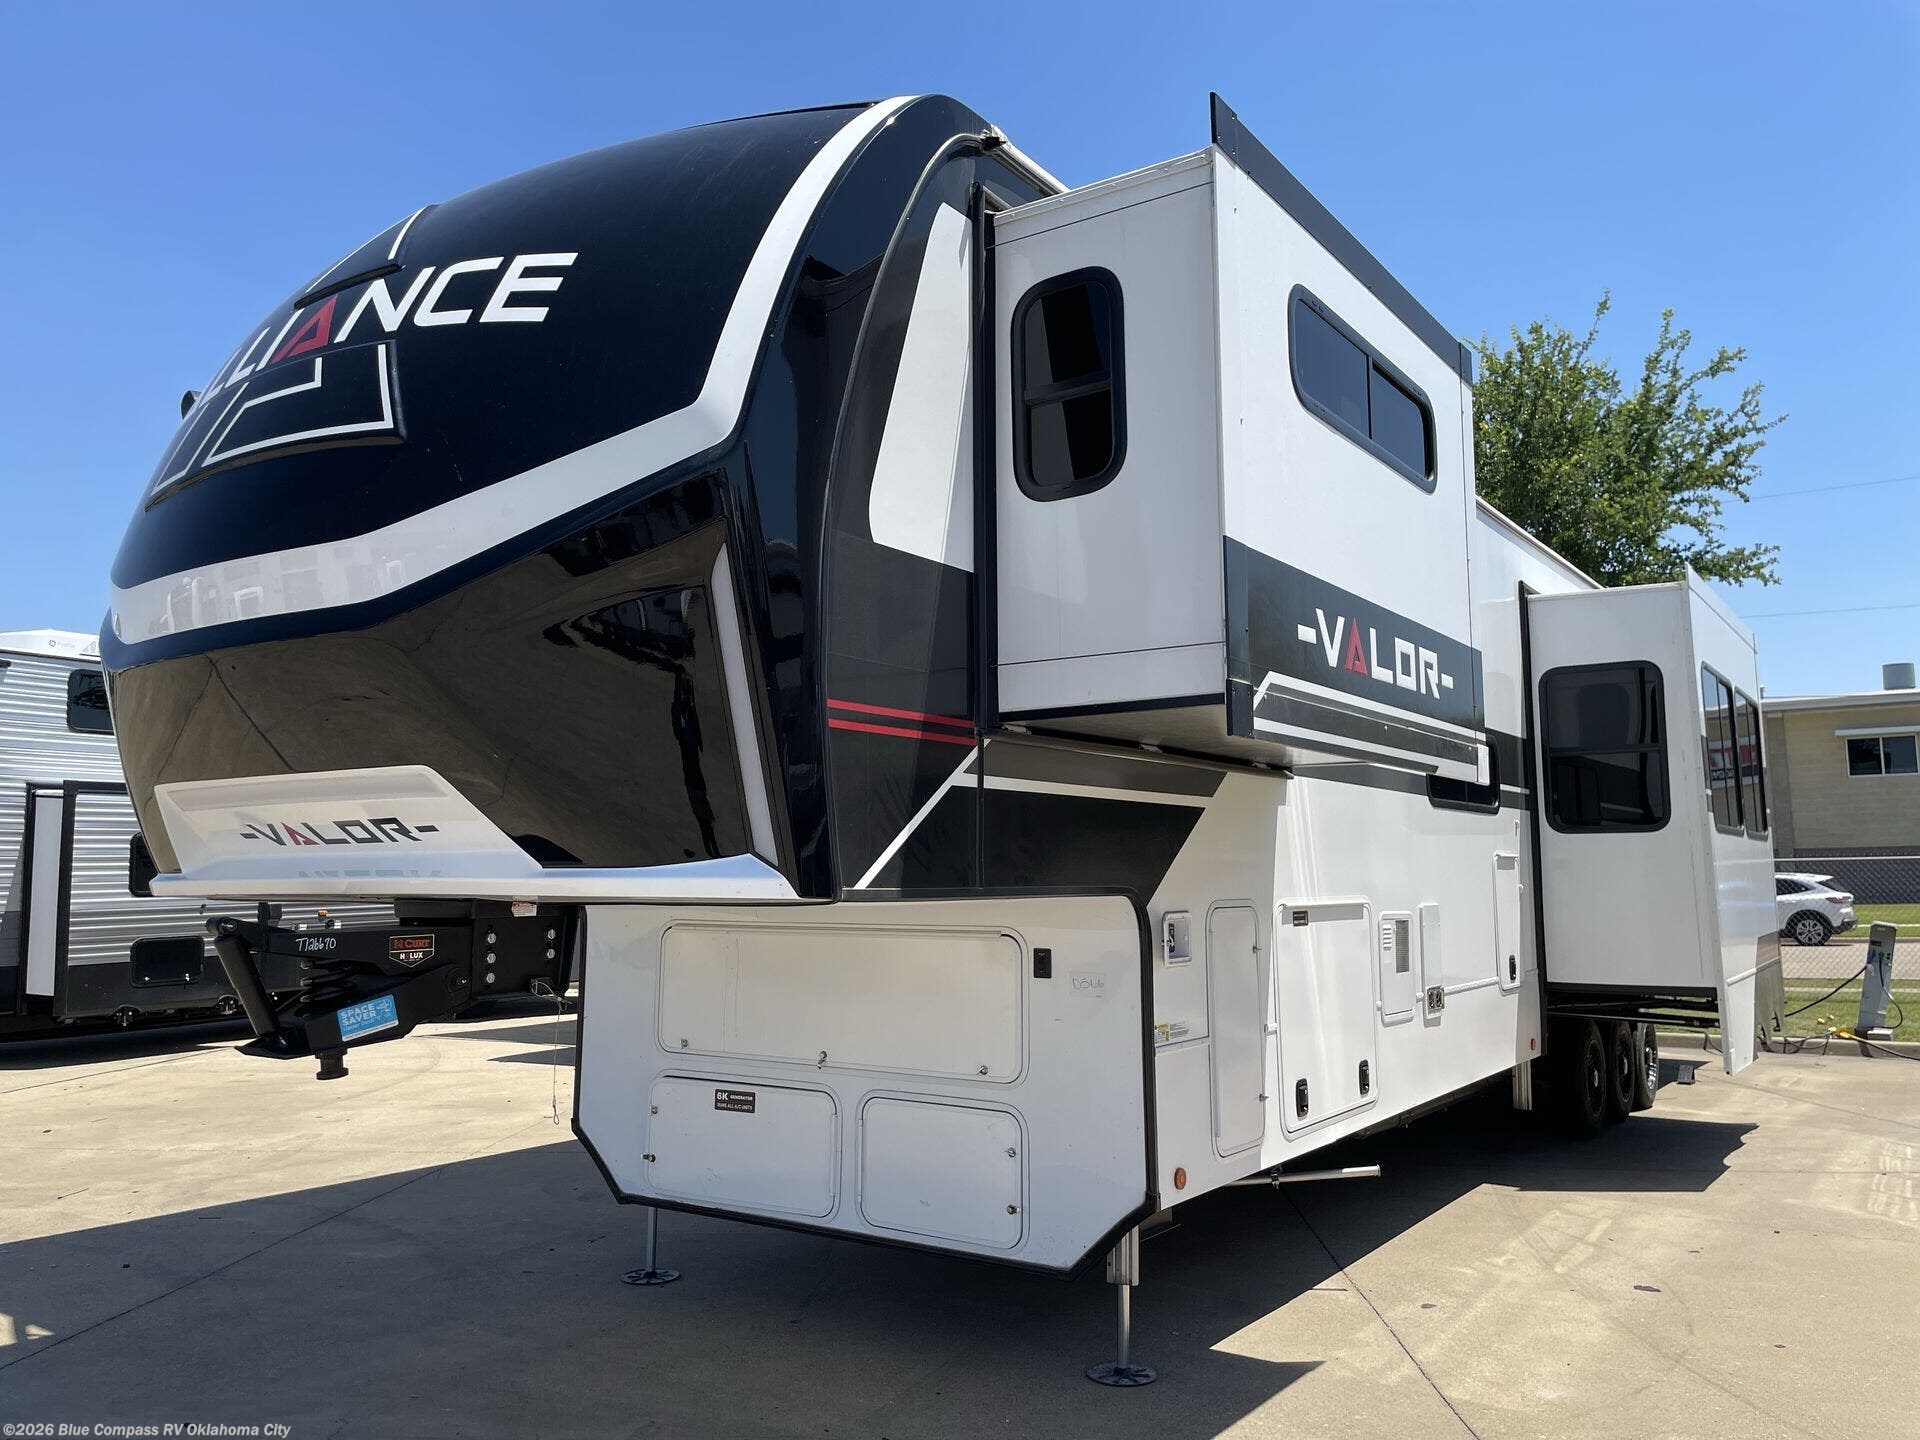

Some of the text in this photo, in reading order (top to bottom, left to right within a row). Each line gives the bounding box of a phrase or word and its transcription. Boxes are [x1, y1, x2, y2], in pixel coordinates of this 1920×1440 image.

[341, 1003, 375, 1019] SPACE
[342, 1010, 377, 1026] SAVER
[716, 1091, 729, 1101] 6K
